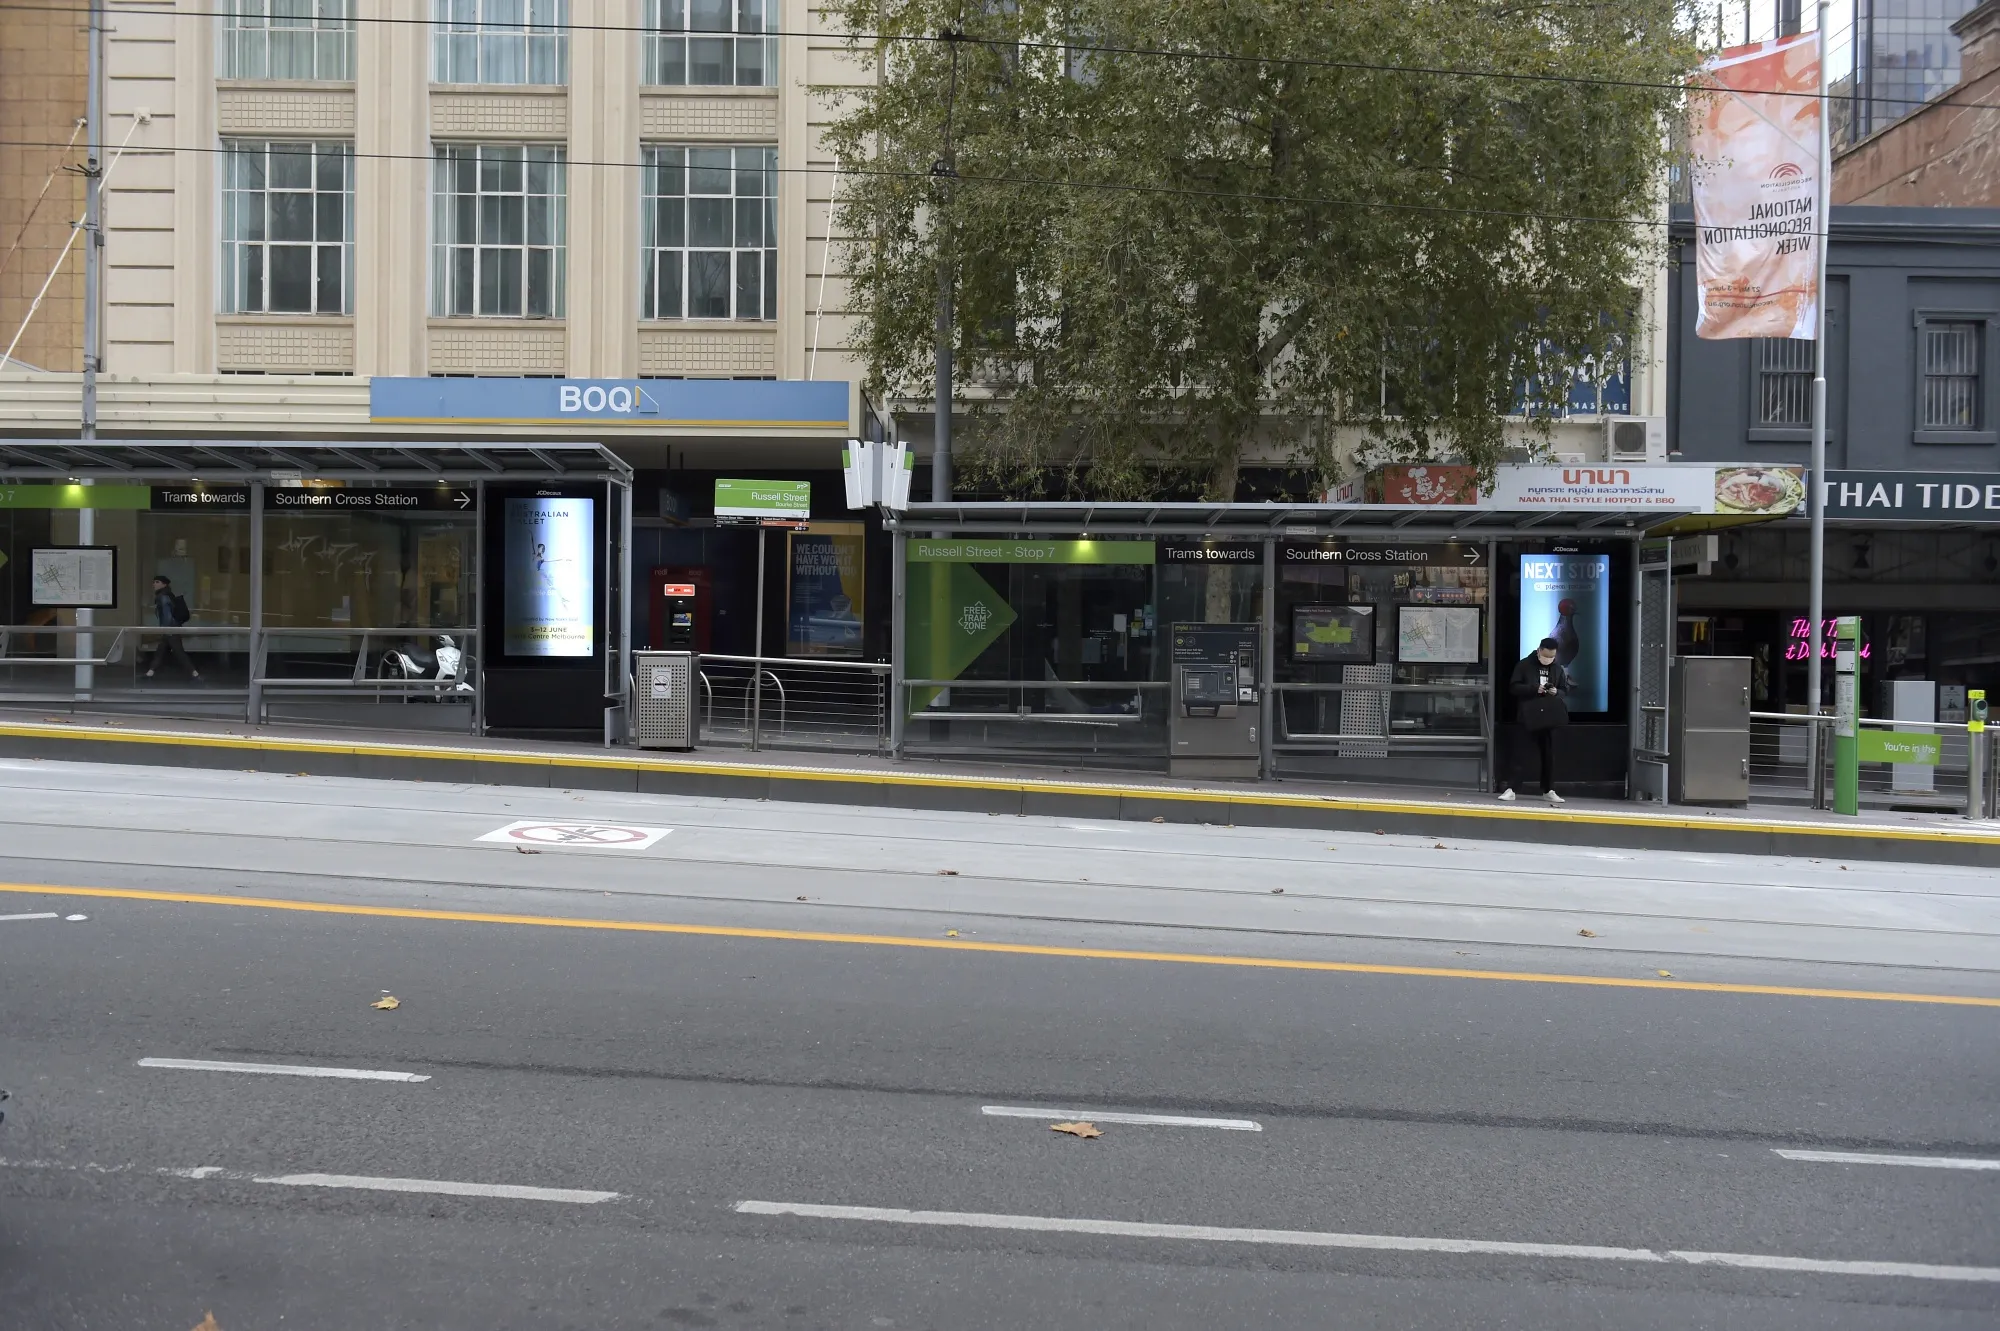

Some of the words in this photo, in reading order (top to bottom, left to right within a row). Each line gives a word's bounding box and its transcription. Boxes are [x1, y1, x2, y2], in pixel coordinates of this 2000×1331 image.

[559, 386, 632, 414] BOQ
[1573, 402, 1628, 411] MASAGE
[1563, 469, 1630, 485] นานา
[8, 490, 15, 501] 7
[162, 492, 198, 503] Trams
[200, 492, 246, 503] towards
[276, 494, 332, 505] Southern
[335, 494, 372, 506] Cross
[374, 494, 418, 506] Station
[752, 492, 780, 501] Russell
[782, 492, 808, 502] Street
[1518, 496, 1546, 504] NANA
[1549, 496, 1571, 504] THAI
[1573, 496, 1602, 504] STYLE
[1823, 482, 1903, 508] THAI
[1915, 483, 2000, 511] TIDE
[801, 510, 806, 518] 7
[796, 544, 811, 554] WE
[918, 546, 962, 557] Russell
[966, 546, 1002, 558] Street
[1014, 547, 1044, 560] Stop
[1048, 548, 1056, 558] 7
[1166, 548, 1202, 559] Trams
[1206, 548, 1255, 560] towards
[1286, 548, 1342, 560] Southern
[1346, 549, 1382, 560] Cross
[1385, 550, 1428, 561] Station
[796, 554, 819, 565] HAVE
[796, 565, 837, 576] WITHOUT
[1524, 562, 1564, 578] NEXT
[1568, 562, 1605, 579] STOP
[964, 606, 986, 614] FREE
[964, 622, 986, 630] ZONE
[1850, 662, 1854, 670] 7
[1884, 741, 1910, 752] You're
[1912, 744, 1920, 753] in
[1921, 744, 1936, 754] the
